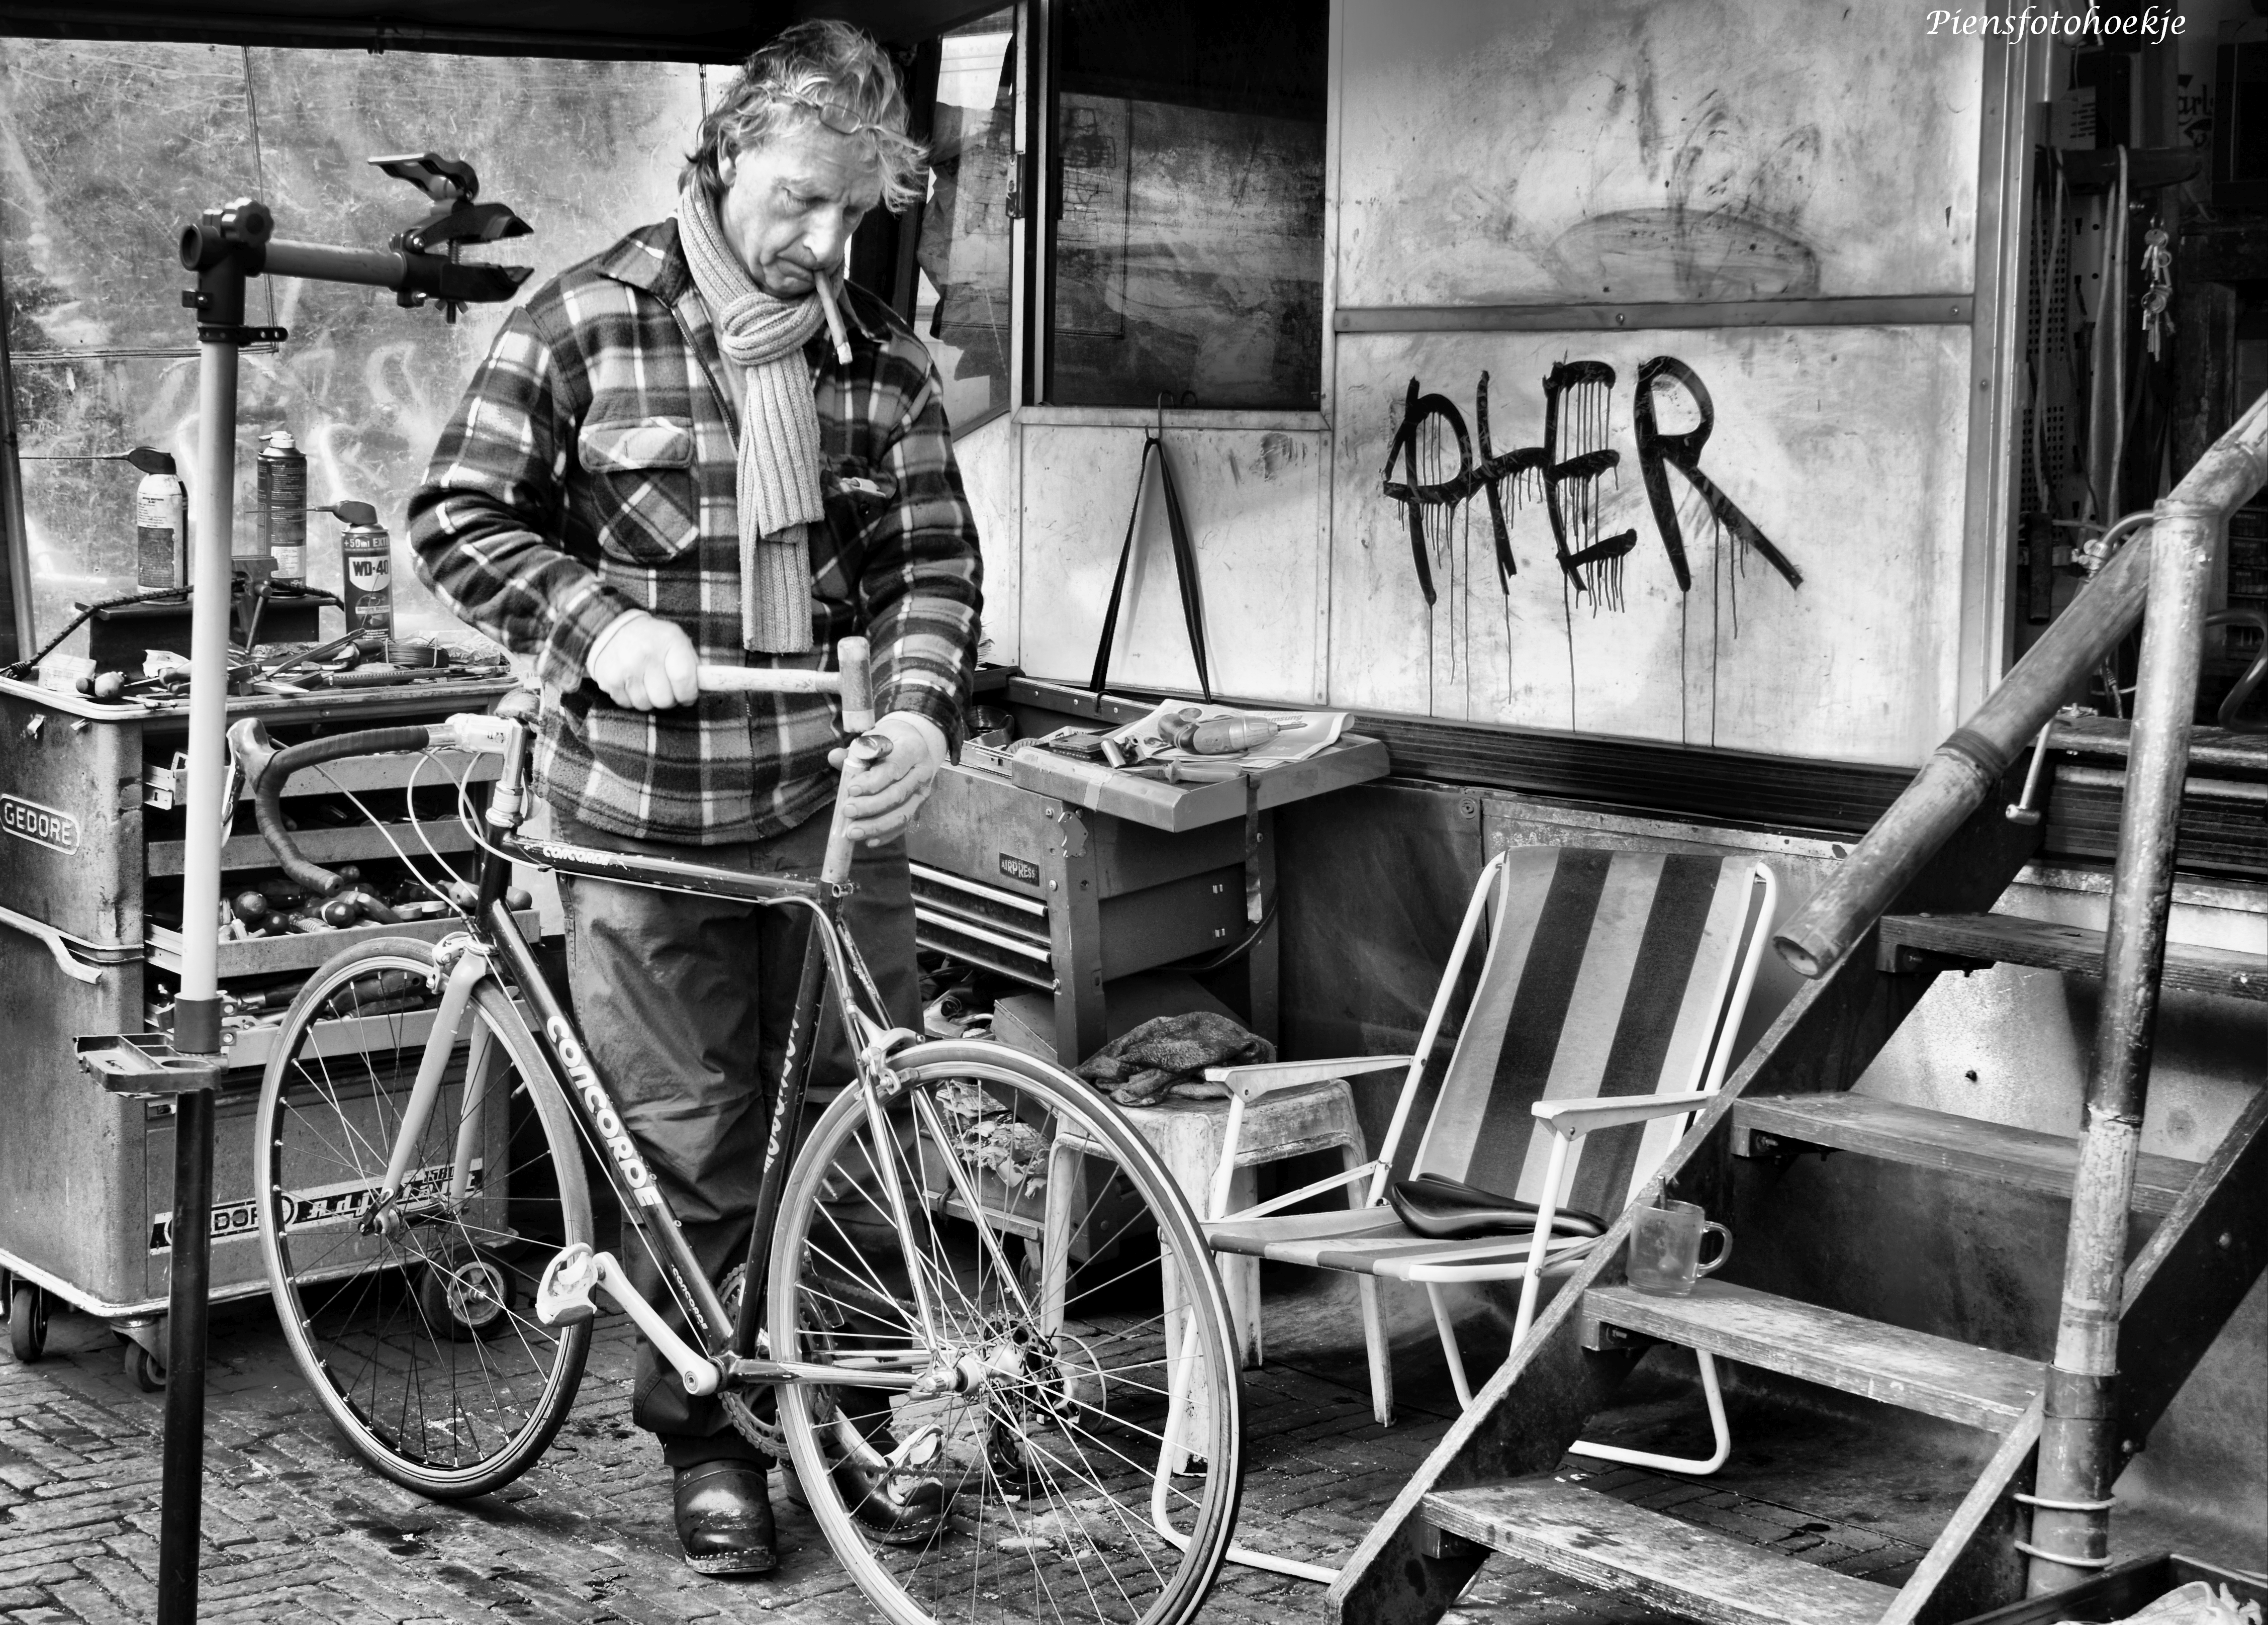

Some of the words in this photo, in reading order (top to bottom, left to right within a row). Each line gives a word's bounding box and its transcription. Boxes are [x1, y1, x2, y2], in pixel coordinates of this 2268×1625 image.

[352, 560, 389, 577] WD-40
[5, 802, 72, 846] GEDORE
[543, 846, 613, 866] CONCORDE
[1001, 860, 1035, 878] AIRPRESS
[547, 1016, 664, 1207] CONCORDE
[673, 1268, 708, 1329] CONCORDE
